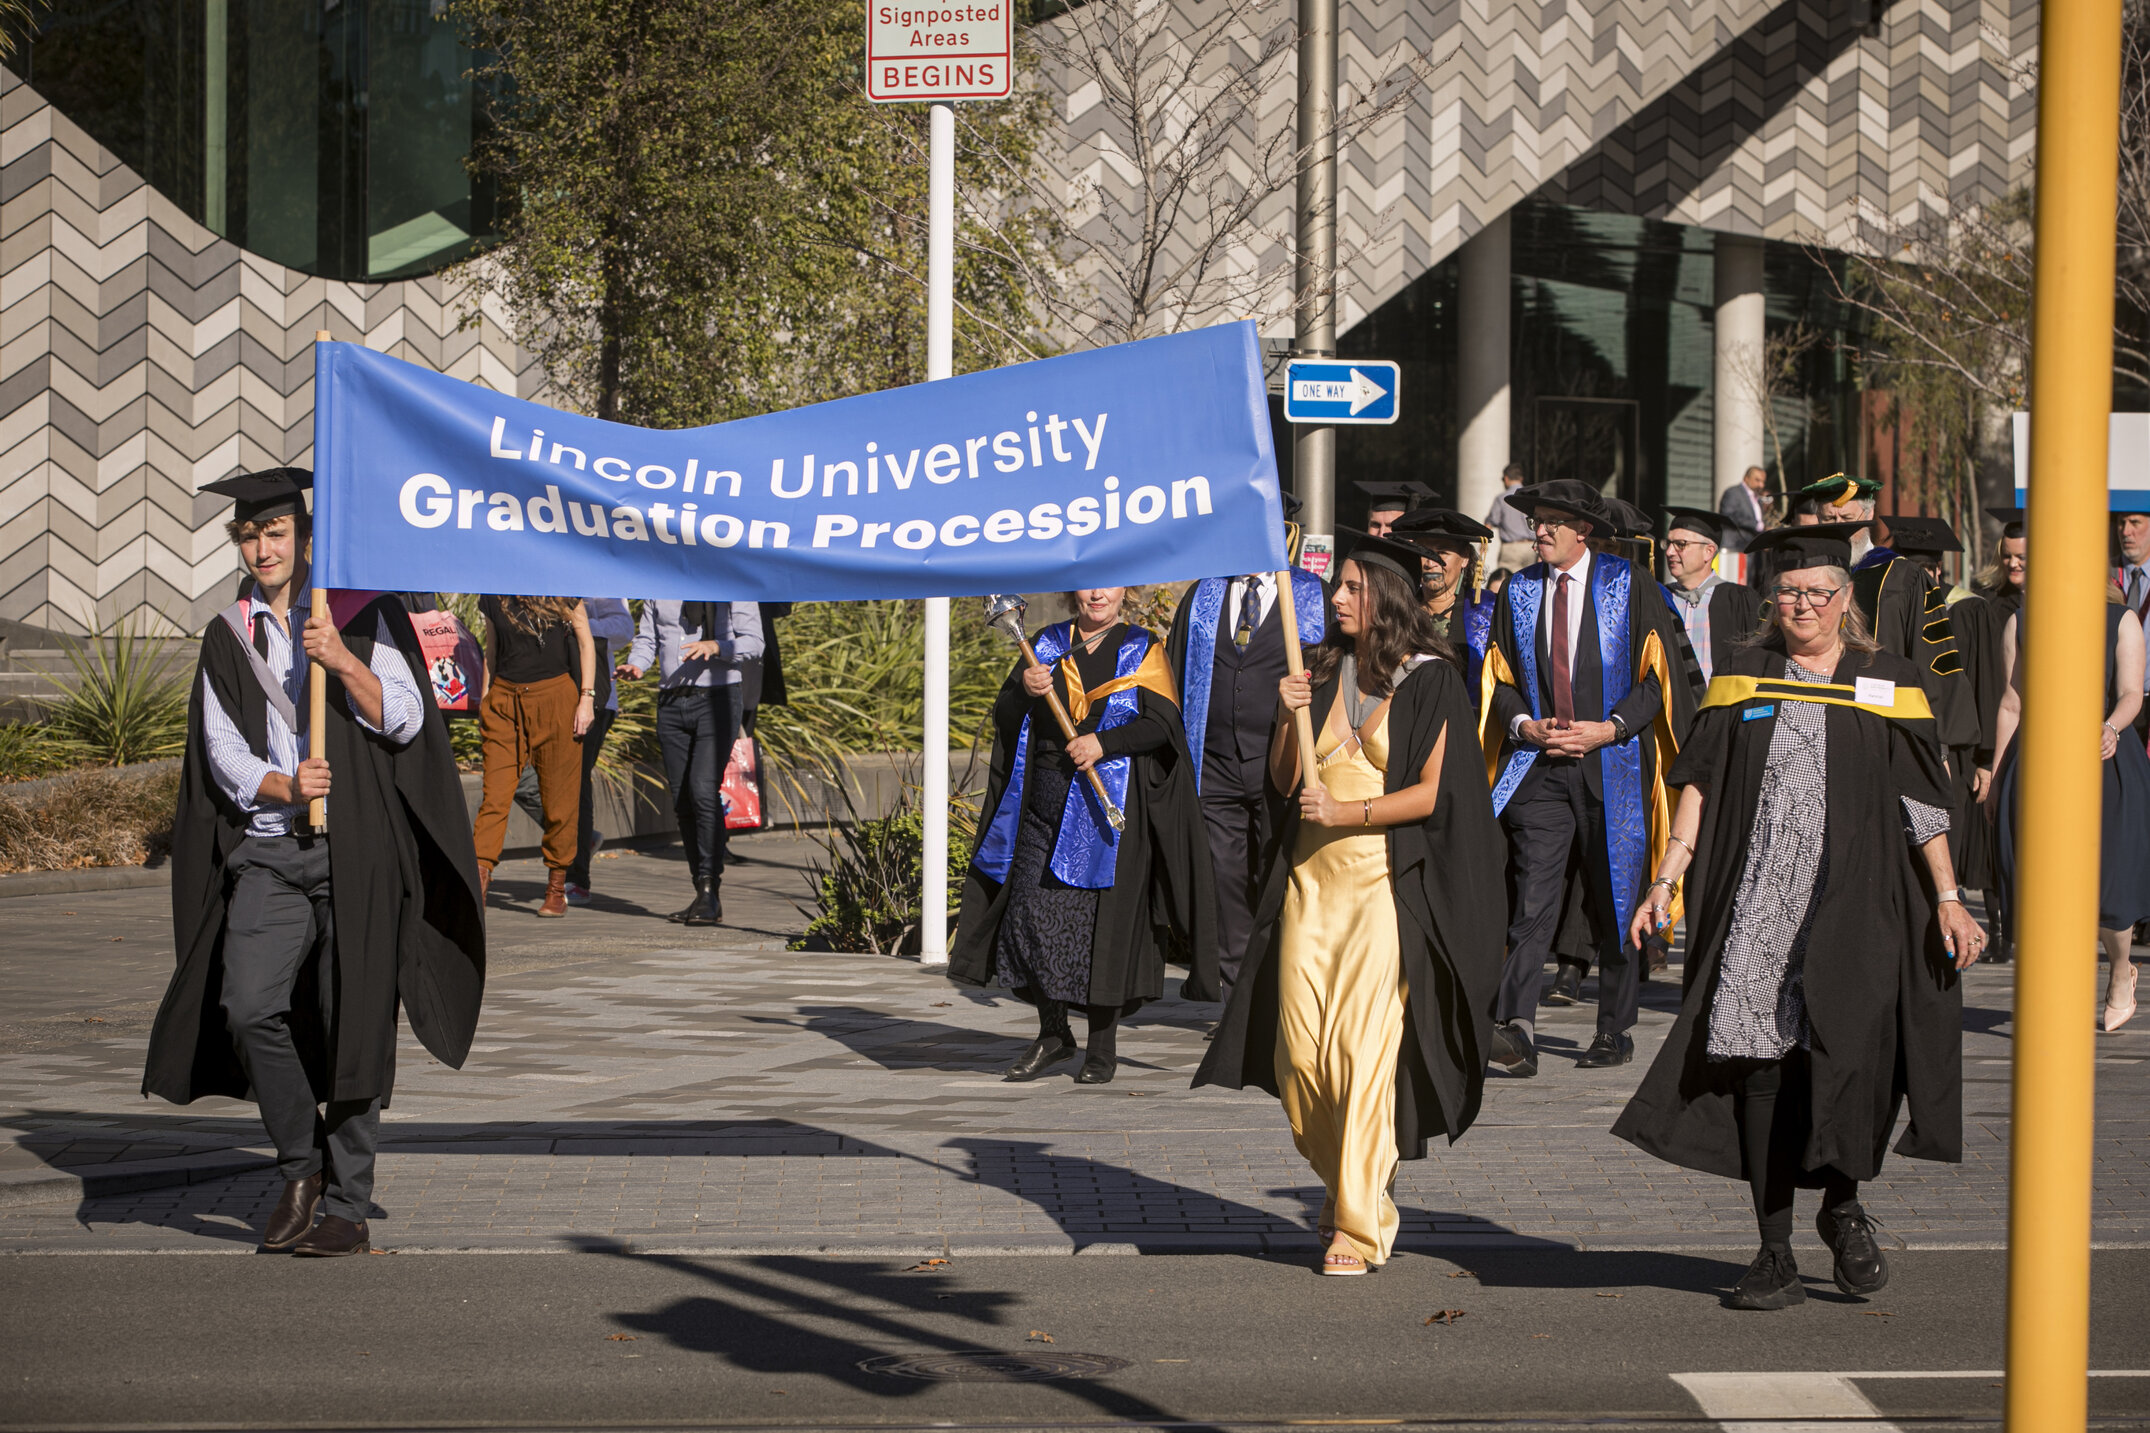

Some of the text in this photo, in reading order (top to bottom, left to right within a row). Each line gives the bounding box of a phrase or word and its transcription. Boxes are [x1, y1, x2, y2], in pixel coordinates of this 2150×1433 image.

[880, 4, 1000, 27] Signposted
[909, 30, 970, 47] Areas
[884, 64, 994, 88] BEGINS
[1302, 384, 1345, 398] ONE WAY
[490, 410, 1108, 499] Lincoln University
[399, 472, 1214, 550] Graduation Procession
[422, 626, 457, 637] REGAL
